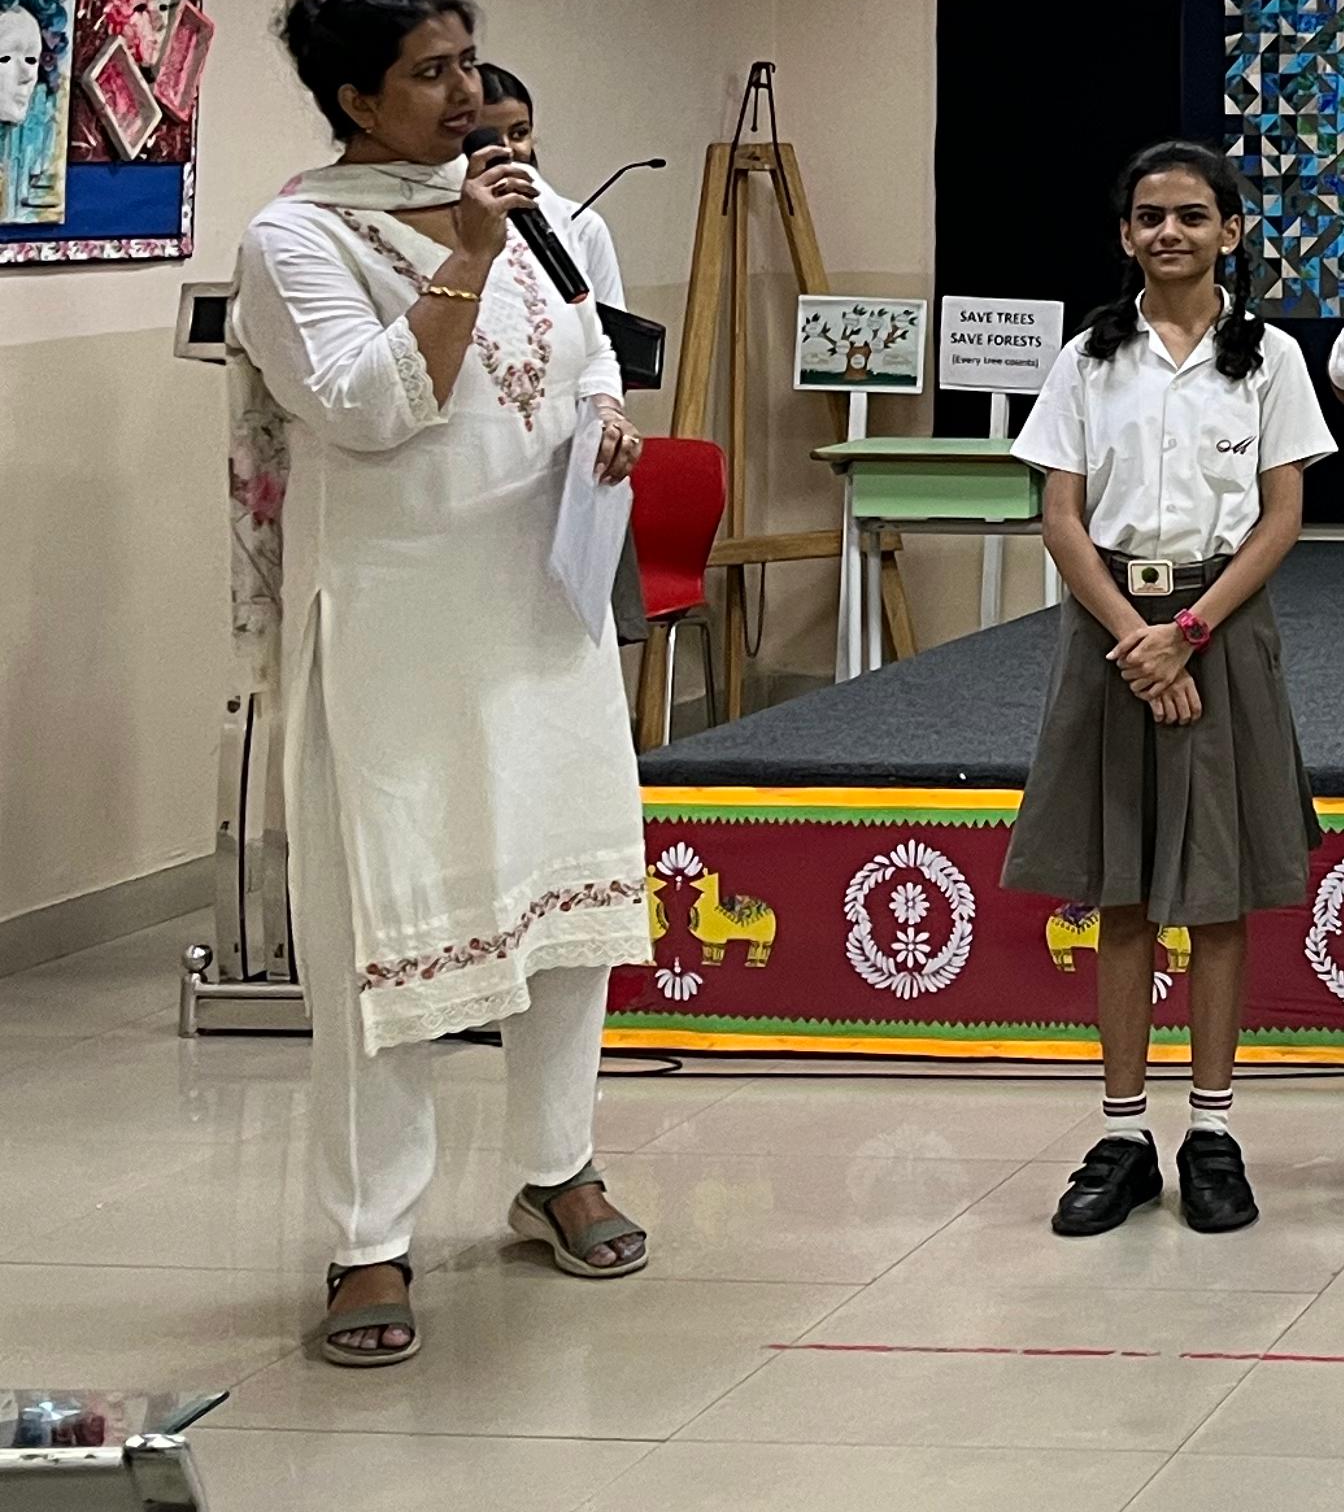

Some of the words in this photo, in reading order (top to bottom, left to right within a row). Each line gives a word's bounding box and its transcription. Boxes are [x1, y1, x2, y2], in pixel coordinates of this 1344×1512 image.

[960, 310, 993, 324] SAVE
[996, 312, 1036, 325] TREES
[950, 332, 983, 345] SAVE
[987, 334, 1042, 348] FORESTS
